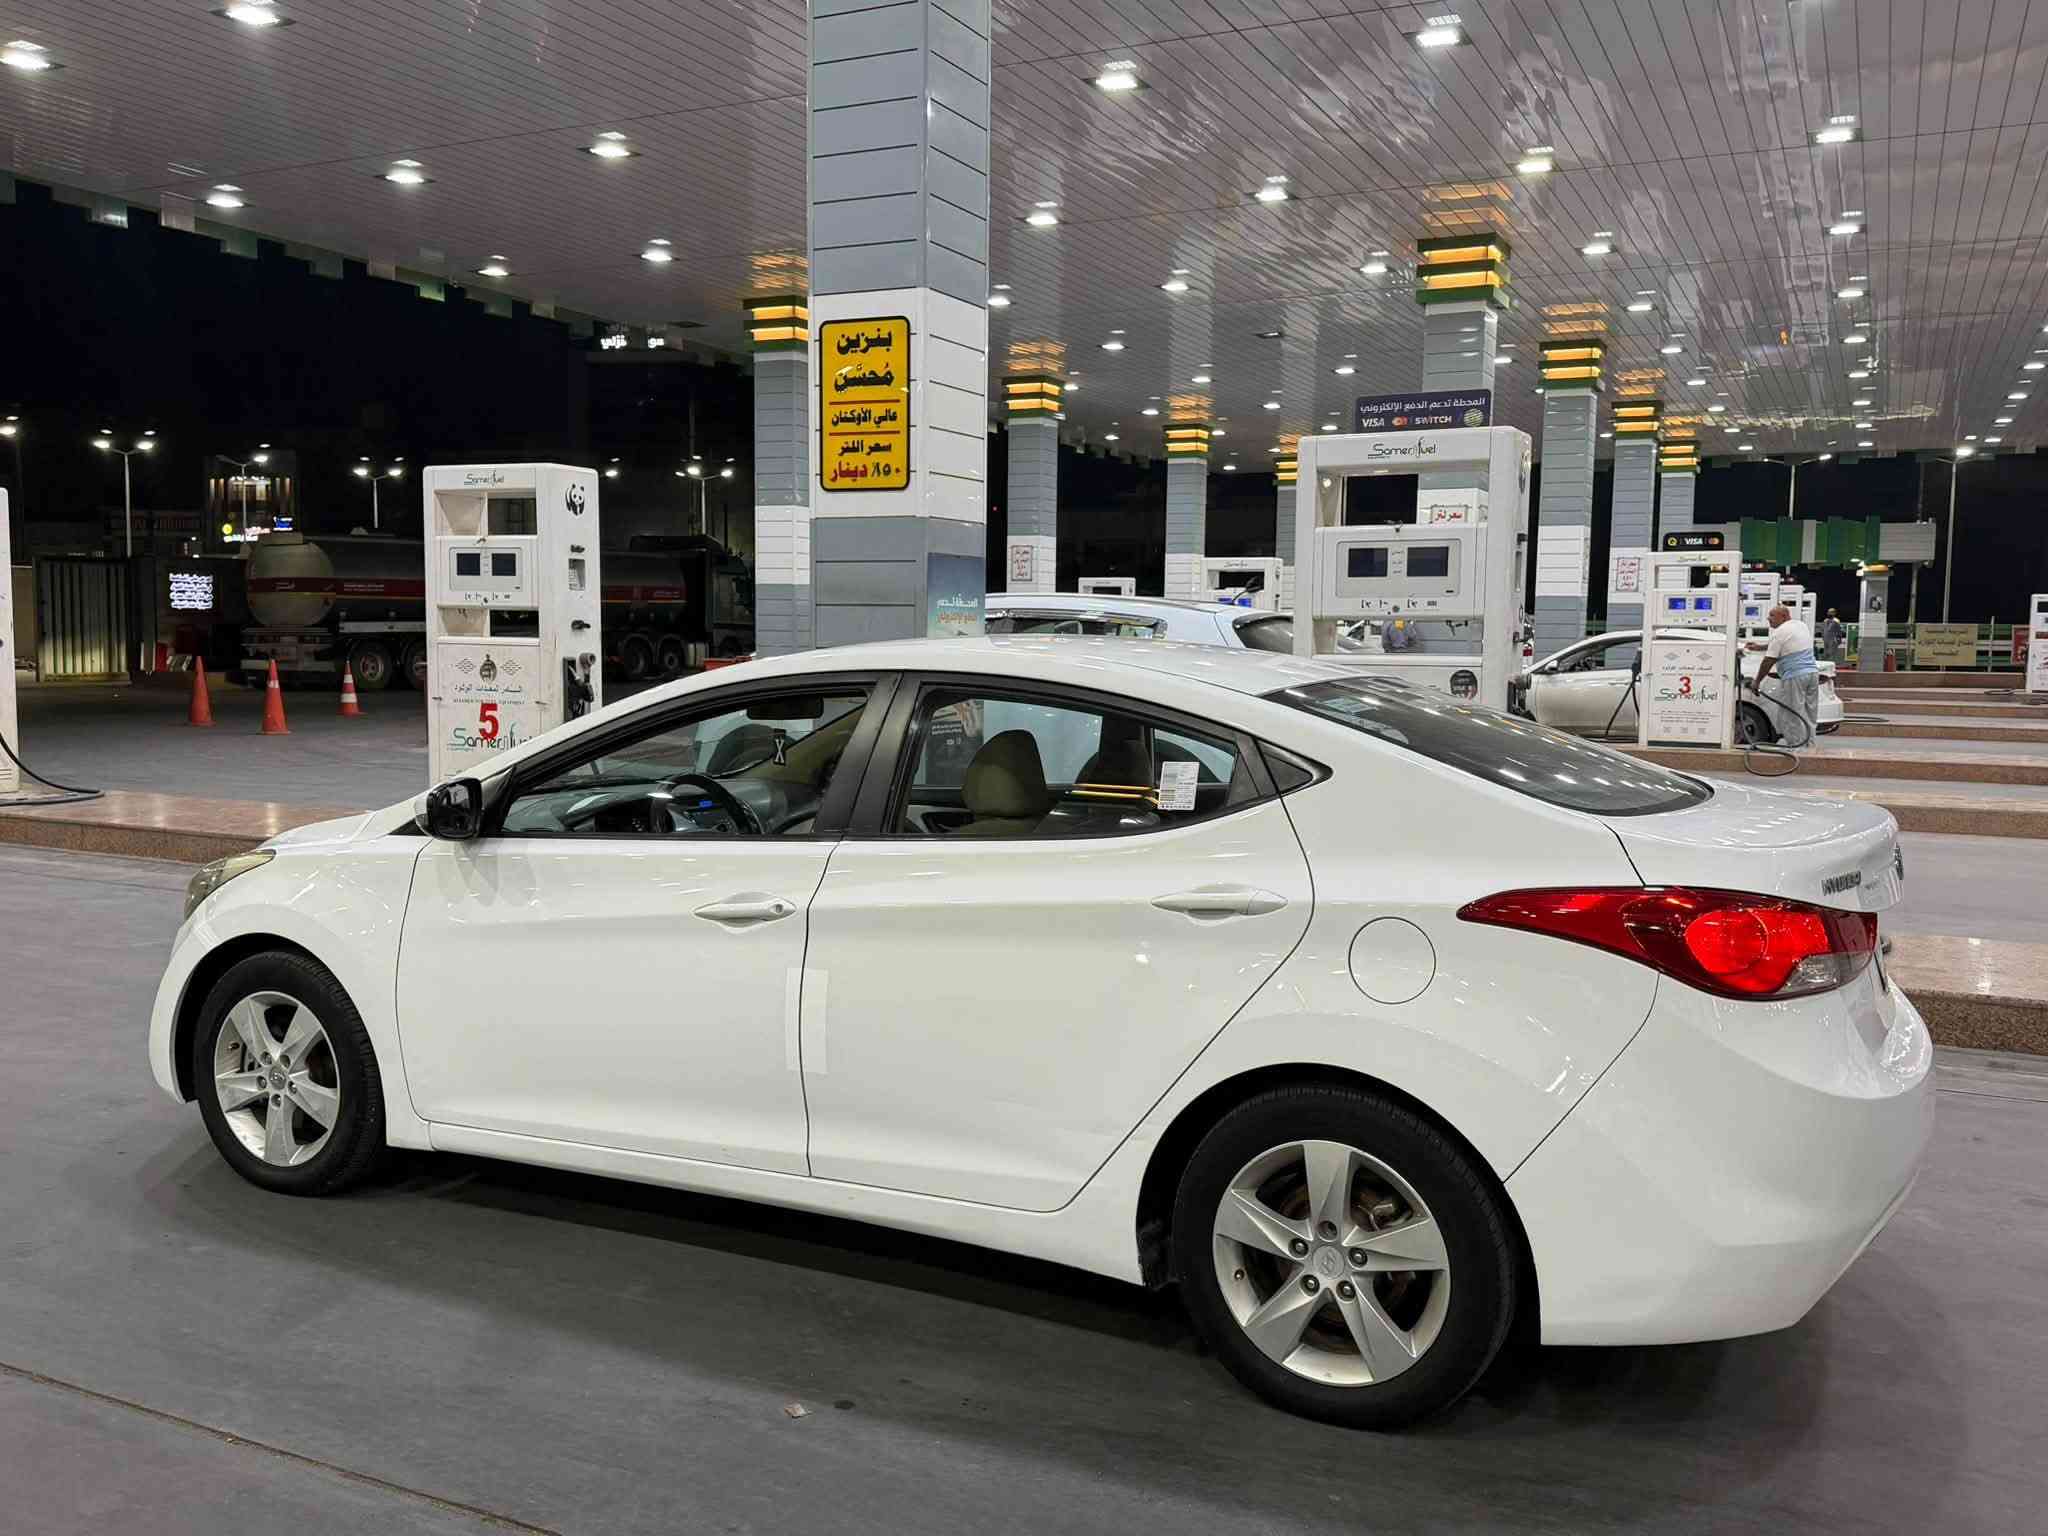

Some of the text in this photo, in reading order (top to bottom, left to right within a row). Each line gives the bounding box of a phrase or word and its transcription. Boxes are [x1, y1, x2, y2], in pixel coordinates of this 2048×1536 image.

[836, 327, 892, 355] بنزين
[1404, 402, 1427, 413] الدفع
[1429, 399, 1451, 412] تدعم
[1453, 397, 1485, 407] المحطة
[1362, 415, 1452, 428] VISA SWITCH
[838, 439, 892, 457] سعر اللتر
[829, 461, 868, 482] دينار
[1684, 537, 1703, 546] VISA
[1679, 676, 1691, 694] 3
[479, 702, 499, 740] 5
